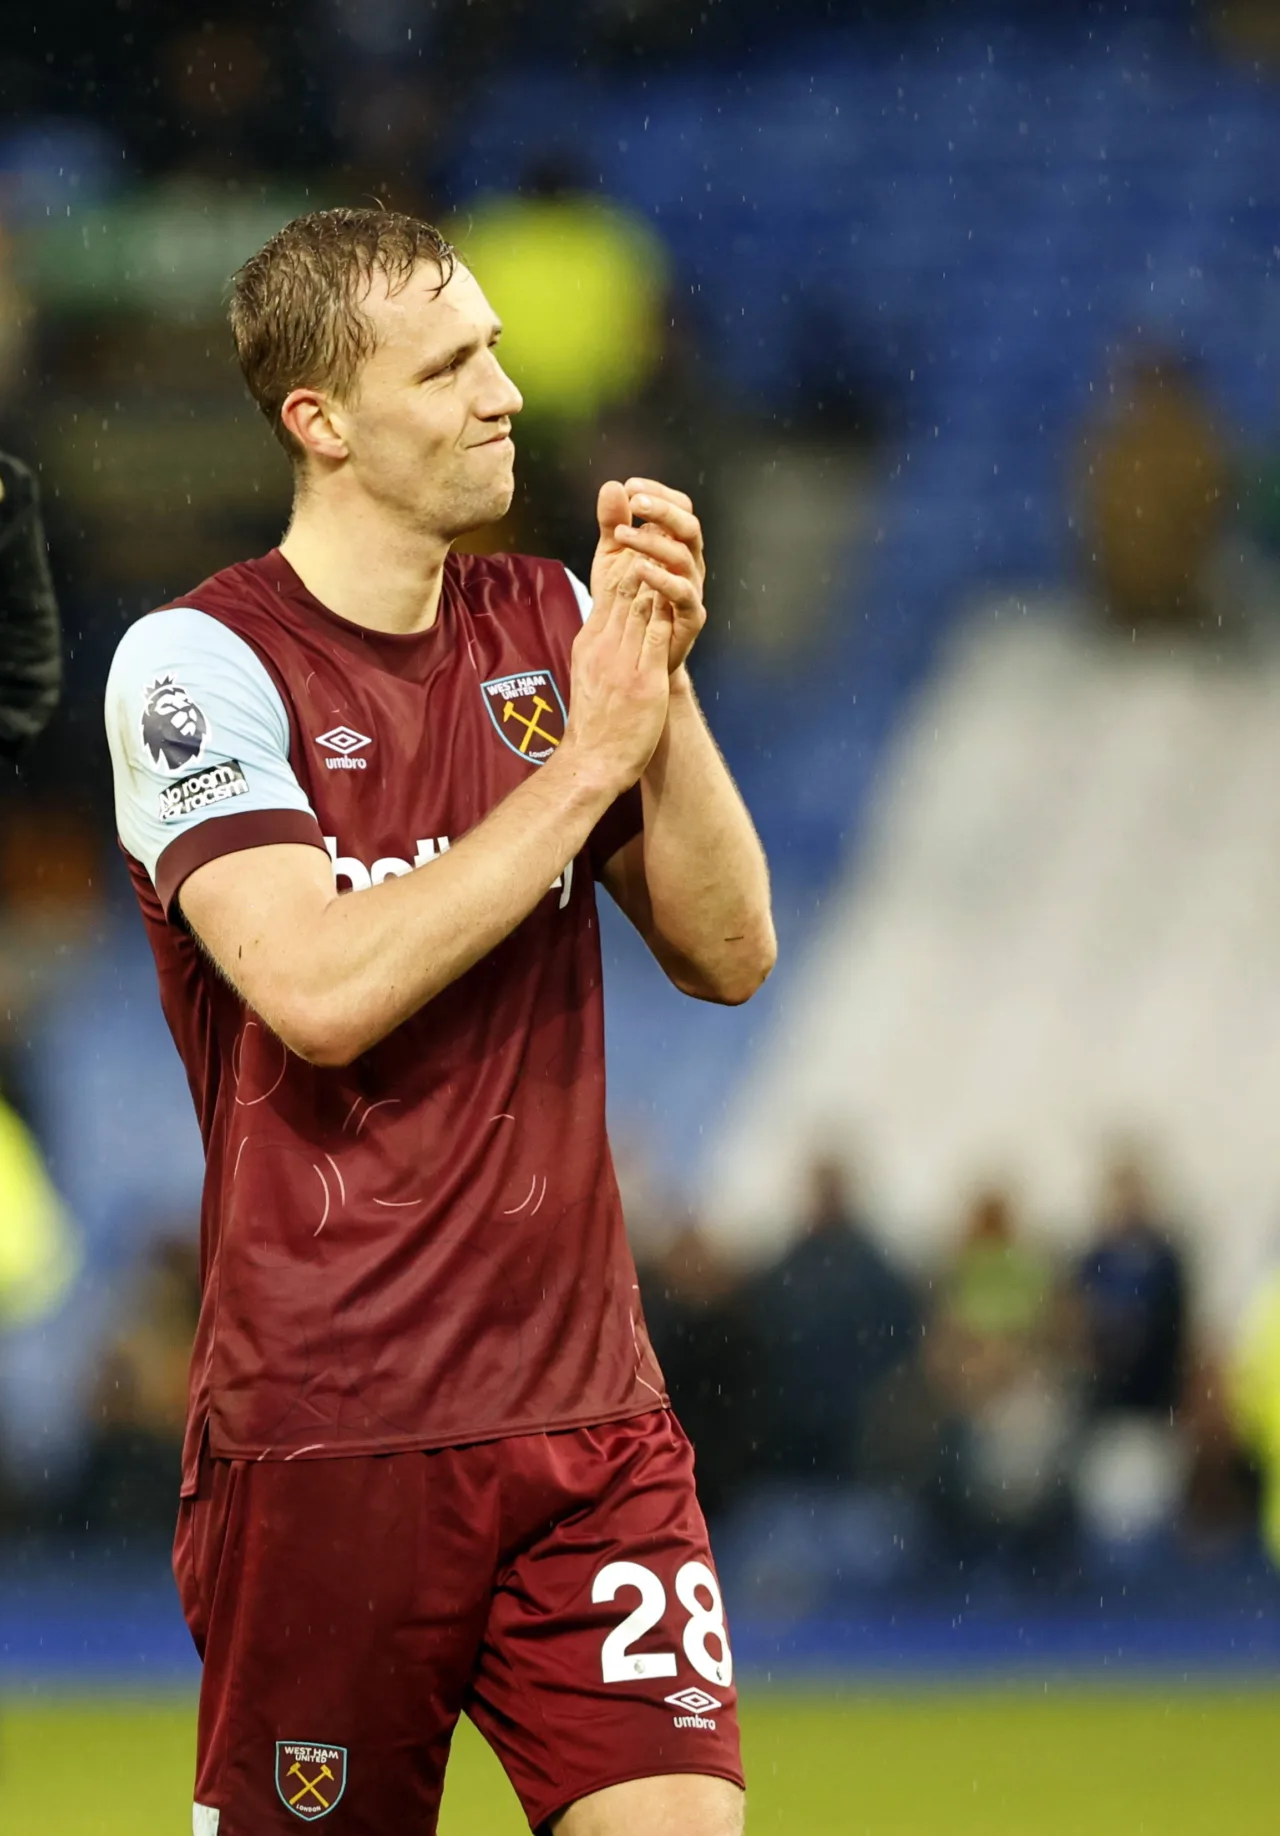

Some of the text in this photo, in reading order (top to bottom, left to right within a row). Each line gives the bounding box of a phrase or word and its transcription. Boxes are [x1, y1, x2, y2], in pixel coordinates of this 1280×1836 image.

[486, 675, 547, 696] WEST HAM
[501, 686, 537, 700] UNITED
[325, 754, 367, 770] umbro
[159, 765, 235, 810] No room
[184, 778, 250, 814] racism
[591, 1561, 733, 1688] 28
[673, 1713, 716, 1731] umbro
[284, 1746, 339, 1760] WEST HAM
[295, 1755, 327, 1764] UNITED
[296, 1803, 322, 1813] LONDON
